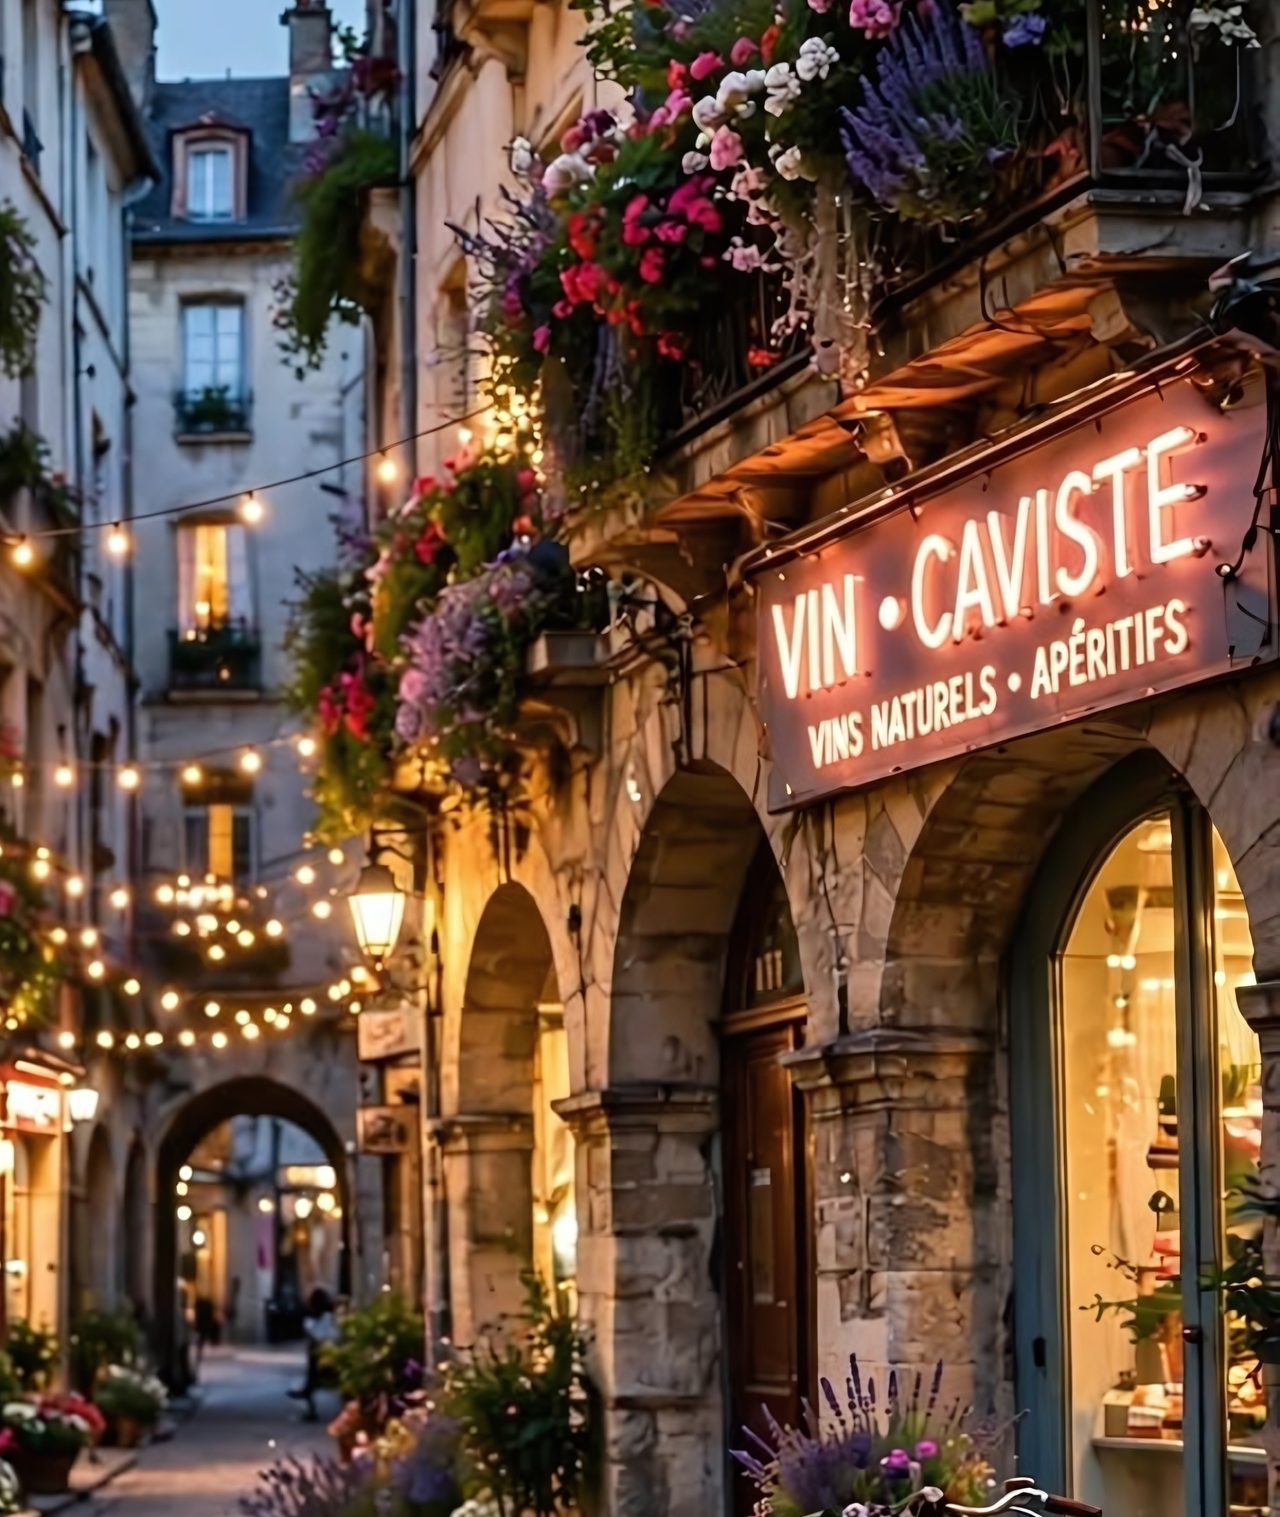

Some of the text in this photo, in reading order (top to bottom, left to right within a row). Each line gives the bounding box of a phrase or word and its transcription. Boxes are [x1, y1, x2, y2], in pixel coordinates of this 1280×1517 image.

[771, 573, 860, 699] VIN
[911, 424, 1204, 649] CAVISTE
[808, 710, 864, 769] VINS
[871, 665, 998, 750] NATURELS
[1031, 599, 1190, 699] APÉRITIFS
